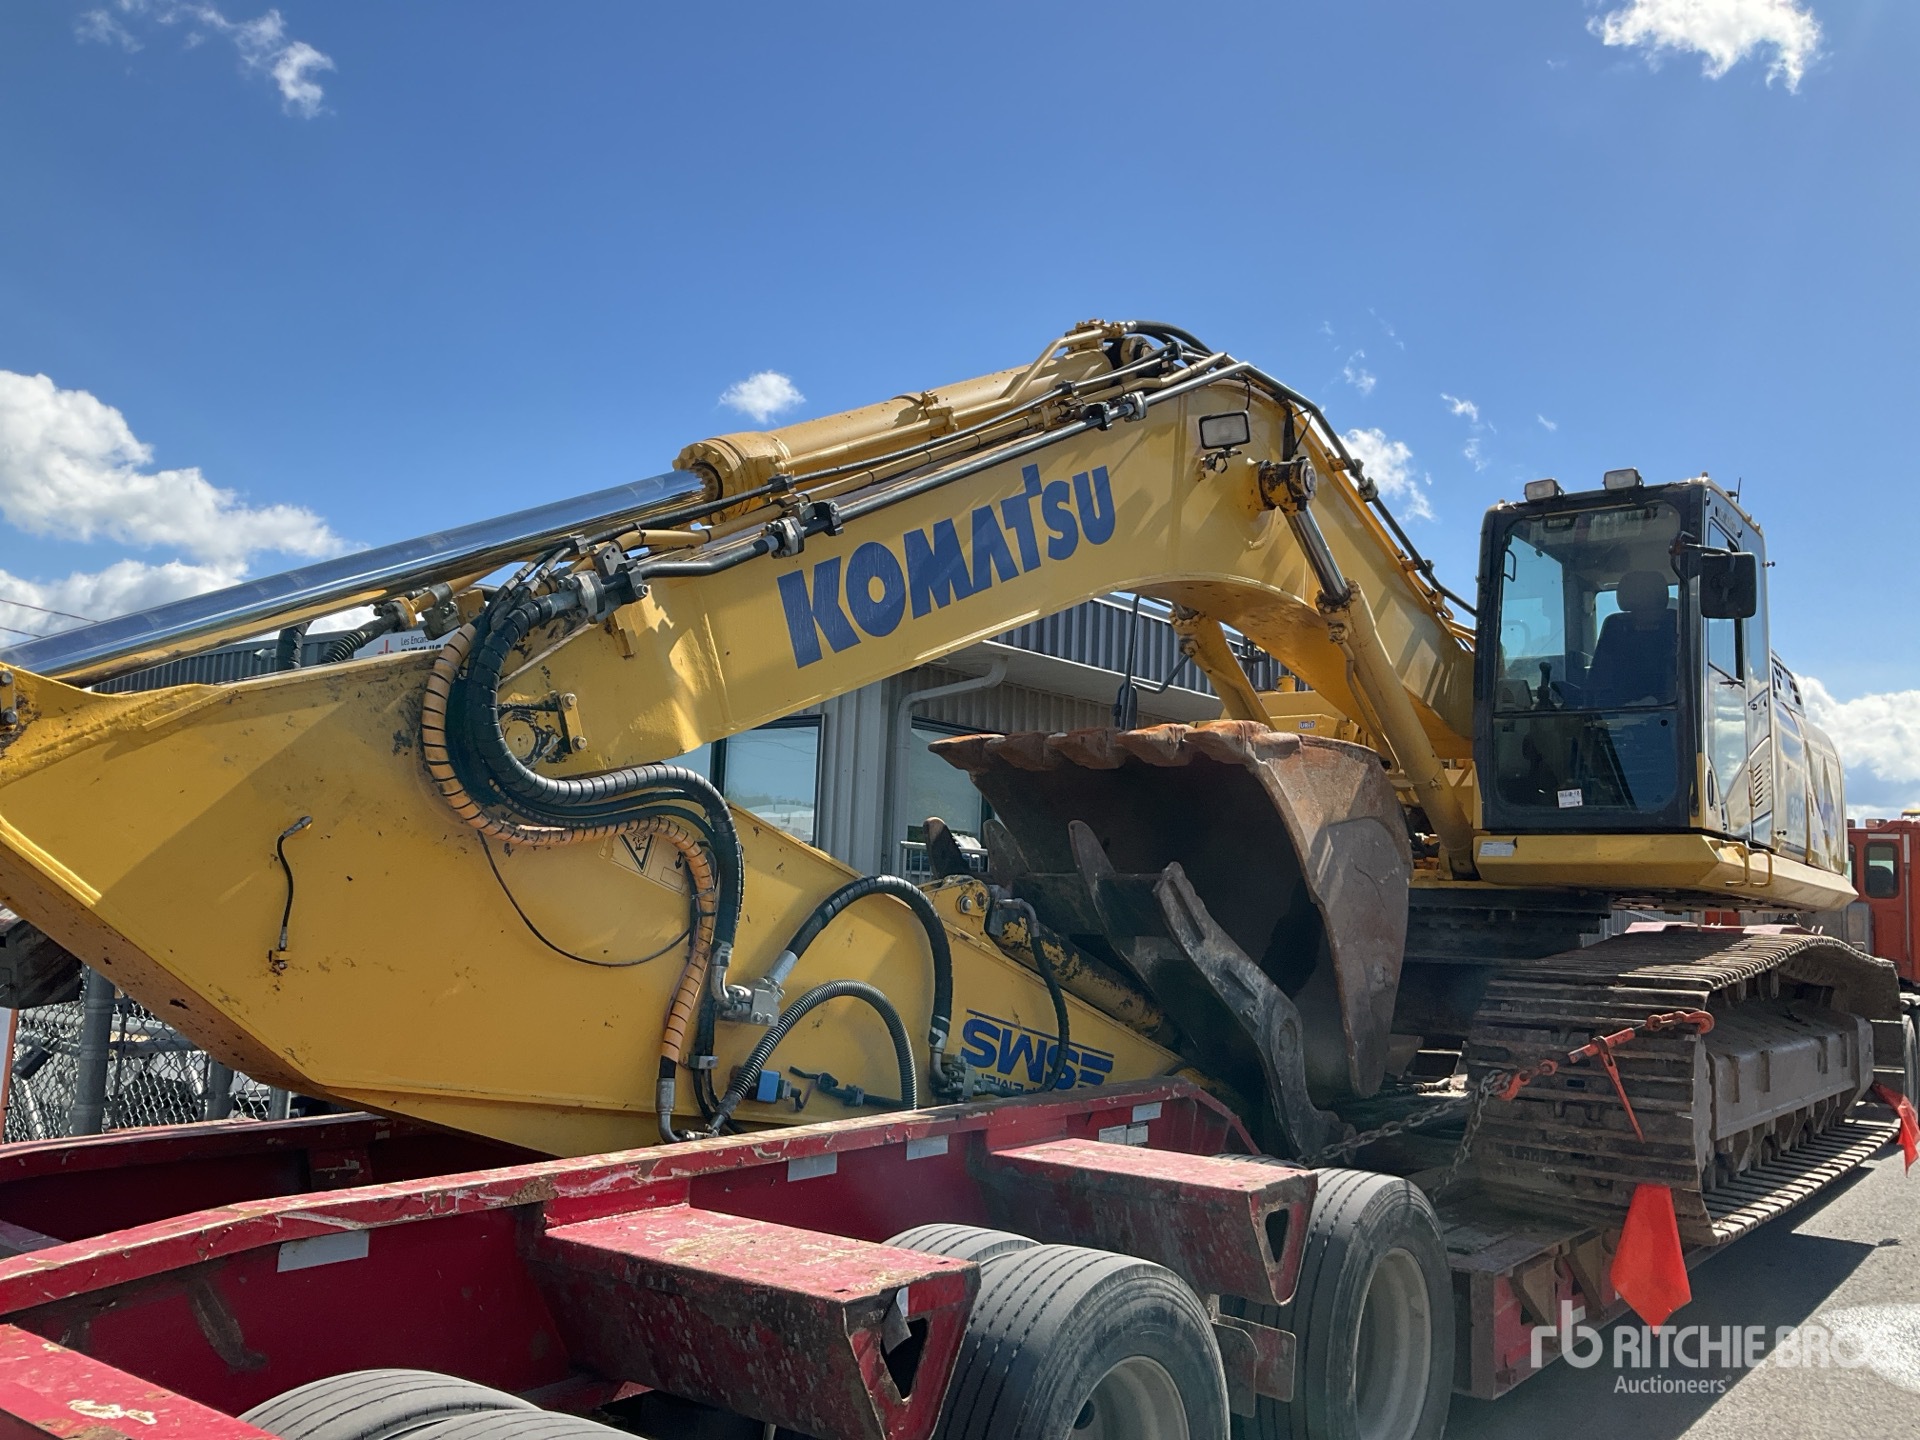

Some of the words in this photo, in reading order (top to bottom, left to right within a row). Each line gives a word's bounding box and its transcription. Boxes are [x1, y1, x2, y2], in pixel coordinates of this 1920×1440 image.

[777, 463, 1116, 669] KOMATSU
[400, 637, 410, 646] Les
[960, 1018, 1080, 1090] SMS
